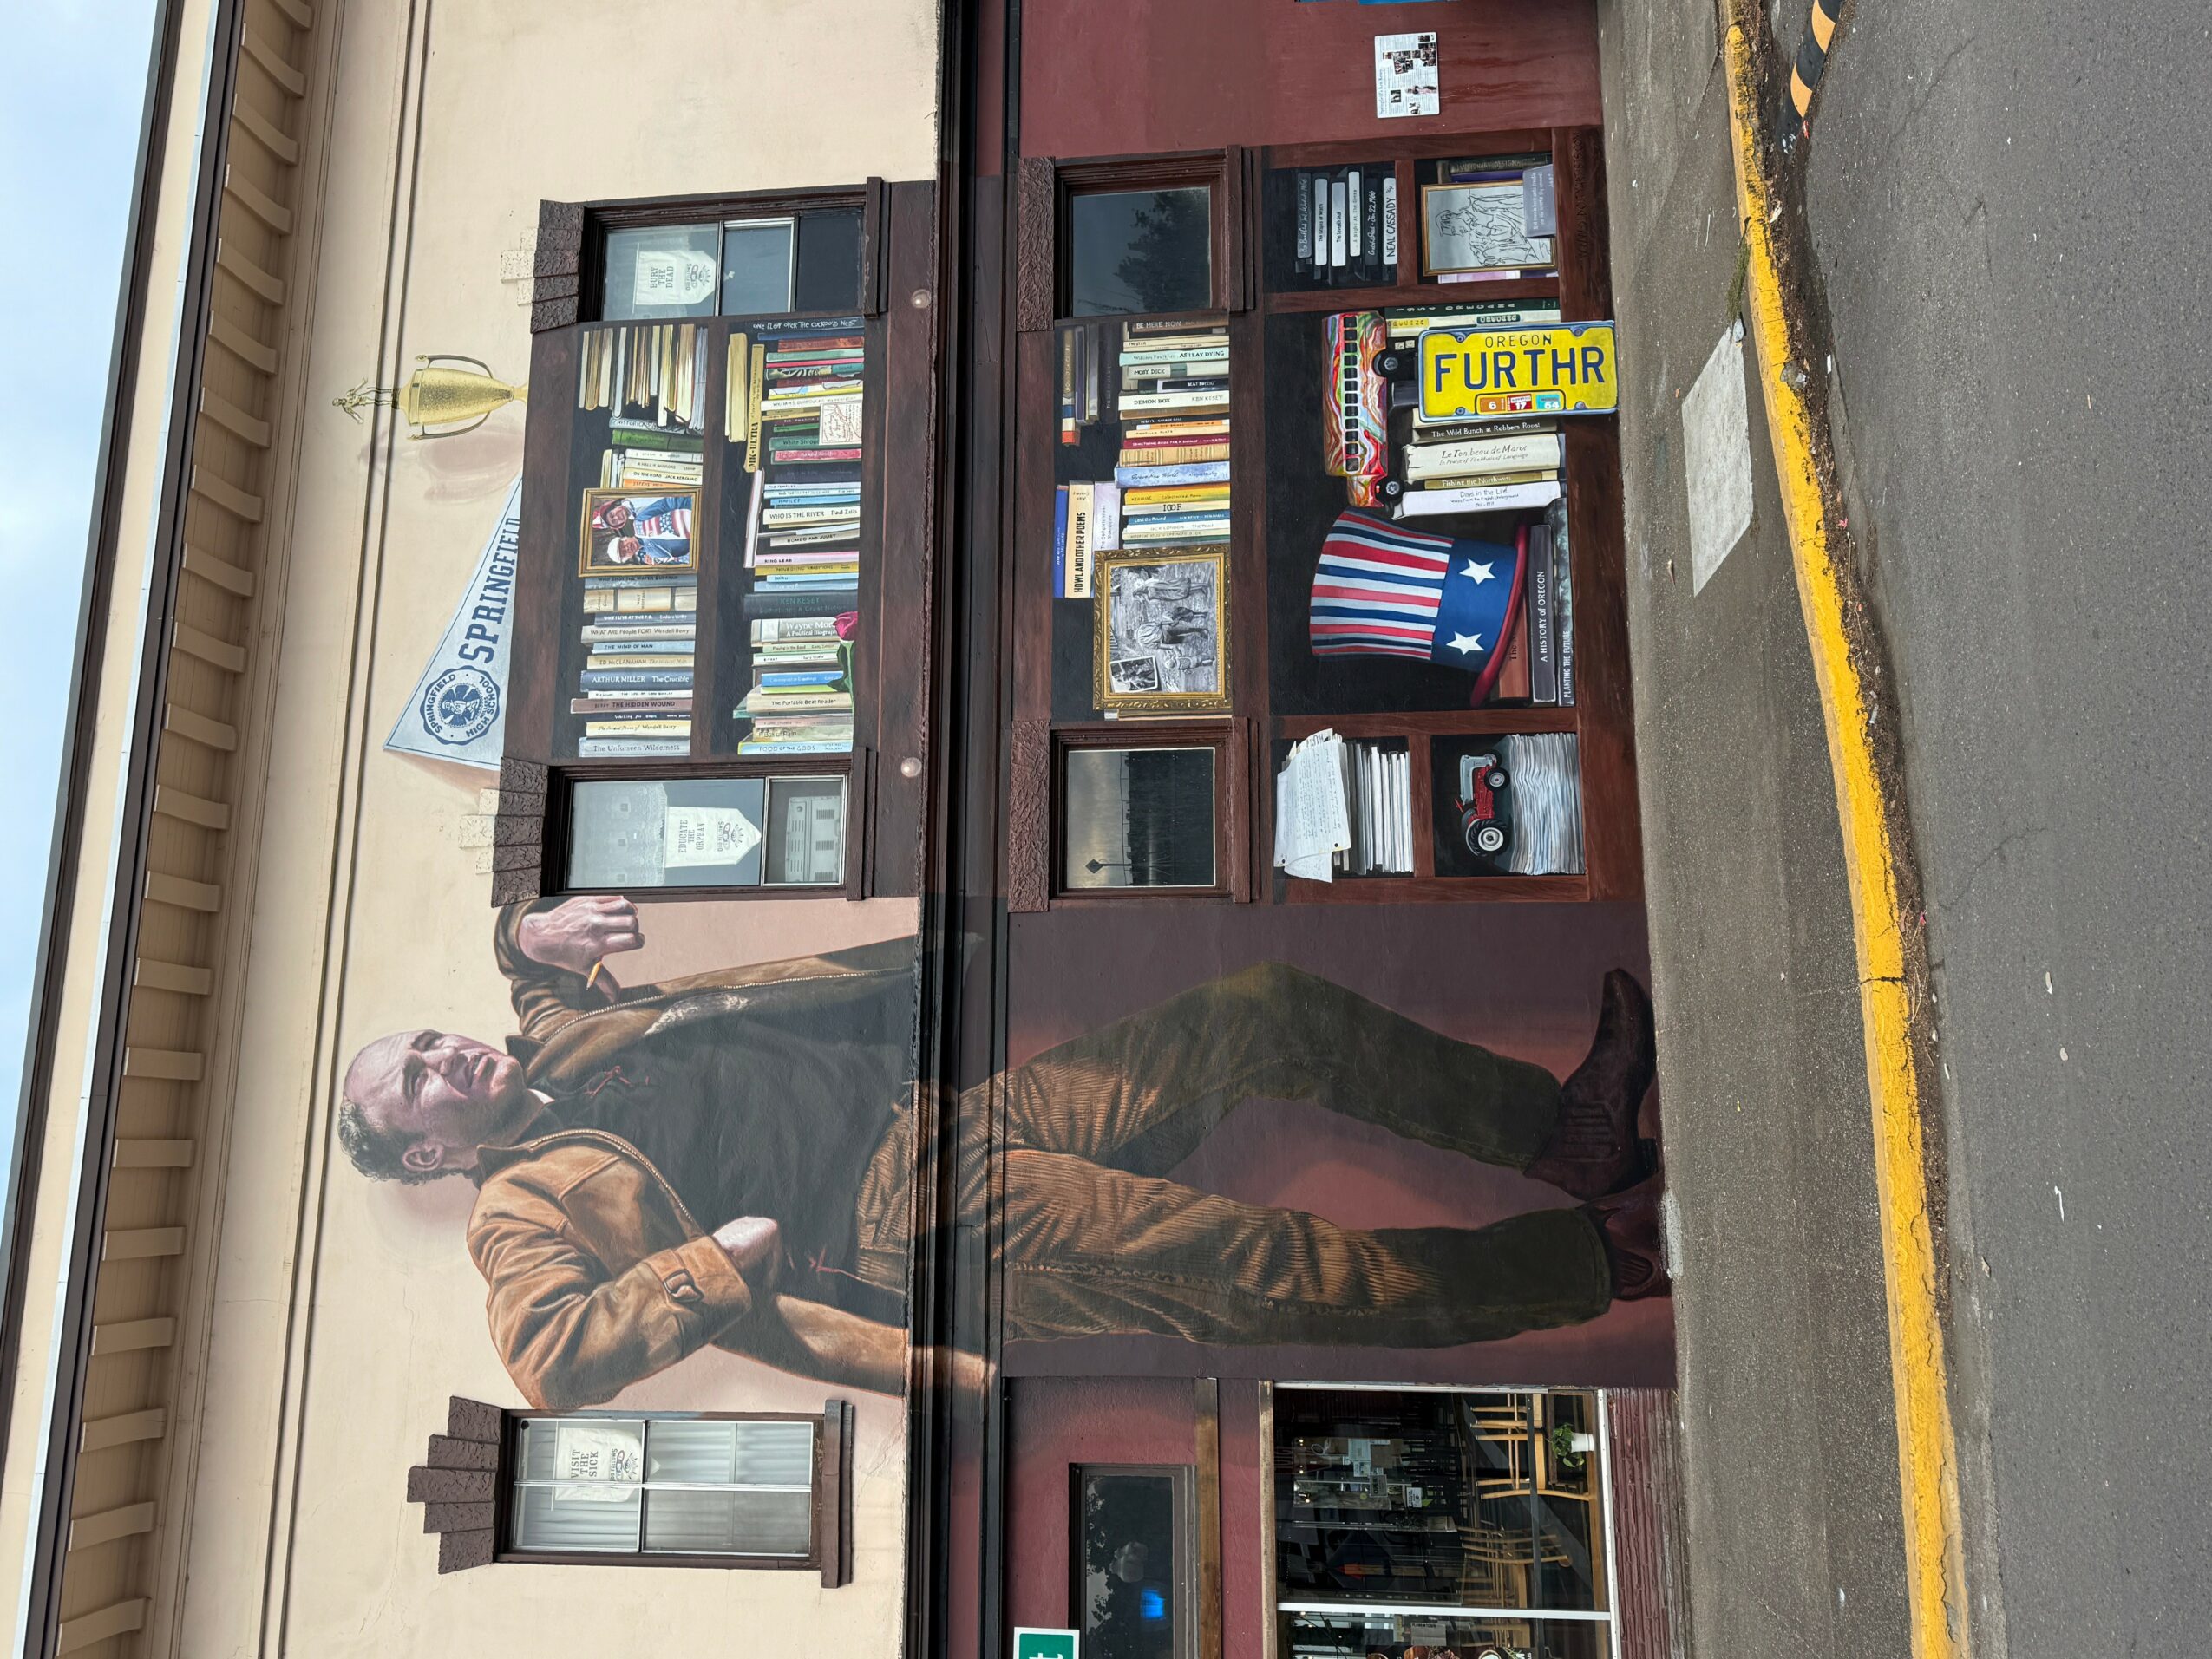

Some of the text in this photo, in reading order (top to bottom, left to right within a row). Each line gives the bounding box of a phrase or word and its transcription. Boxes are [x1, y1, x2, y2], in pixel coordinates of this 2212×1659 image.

[1386, 198, 1396, 258] NEAL CASSADY
[650, 267, 658, 289] BURY
[658, 269, 666, 285] THE
[1485, 334, 1553, 349] OREGON
[1435, 346, 1606, 393] FURTHR
[1489, 401, 1497, 410] 6
[1515, 402, 1527, 410] 17
[1544, 401, 1560, 409] 64
[1454, 449, 1468, 458] Ton
[1470, 447, 1489, 456] beau
[1163, 503, 1182, 512] IOOF
[1076, 512, 1086, 534] POEMS
[1076, 536, 1085, 557] OTHER
[1075, 558, 1084, 572] AND
[458, 517, 521, 664] SPRINGFIELD
[1074, 572, 1083, 593] HOWL
[1537, 571, 1546, 606] OREGON
[1538, 607, 1547, 617] of
[786, 622, 814, 631] Wayne
[1539, 619, 1548, 655] HISTORY
[1562, 631, 1571, 652] FUTURE
[1563, 668, 1572, 698] PLANTING
[425, 673, 457, 735] SPRINGFIELD
[466, 675, 496, 738] HIGH SCHOOL
[479, 696, 489, 719] MILLERS
[678, 820, 688, 853] EDUCATE
[696, 823, 705, 851] ORPHAN
[571, 1450, 581, 1479] VISIT
[579, 1453, 590, 1475] THE
[589, 1452, 599, 1478] SICK
